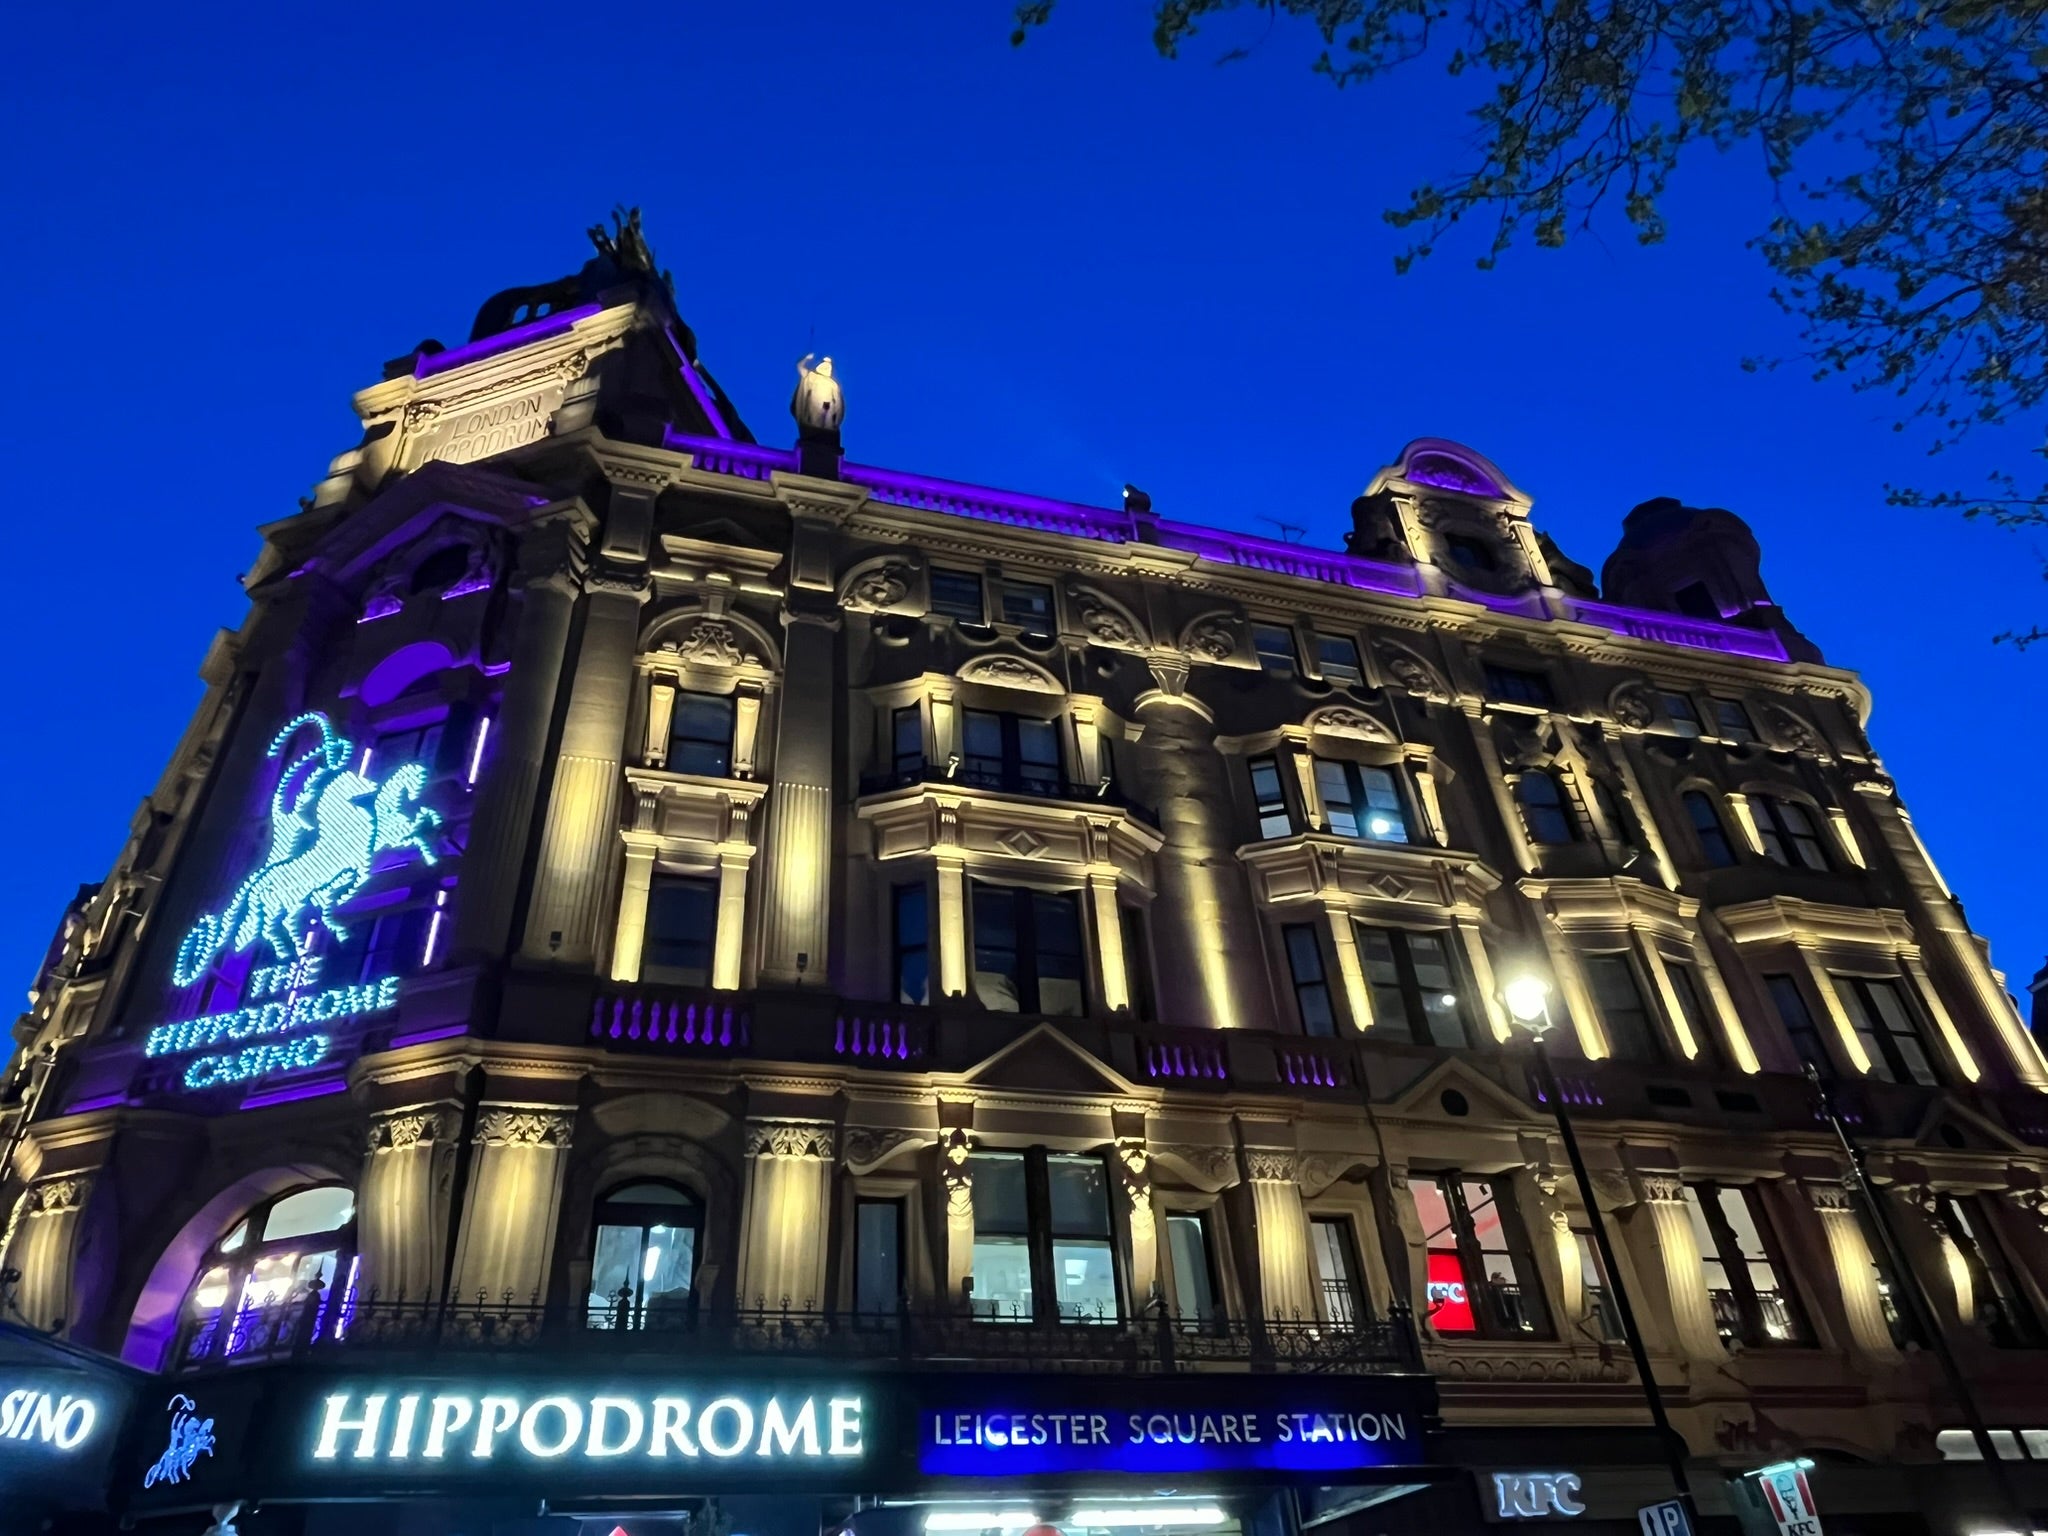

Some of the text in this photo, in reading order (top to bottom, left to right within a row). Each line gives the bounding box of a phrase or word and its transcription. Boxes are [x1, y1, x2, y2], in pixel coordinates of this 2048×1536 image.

[452, 394, 543, 439] LONDON
[251, 955, 322, 997] THE
[146, 976, 399, 1057] HIPPODROME
[184, 1034, 329, 1087] CASINO
[313, 1394, 864, 1457] HIPPODROME
[934, 1412, 1406, 1446] LEICESTER SQUARE STATION
[1492, 1472, 1586, 1517] KFC
[1664, 1507, 1680, 1536] P
[1787, 1520, 1816, 1536] KFC
